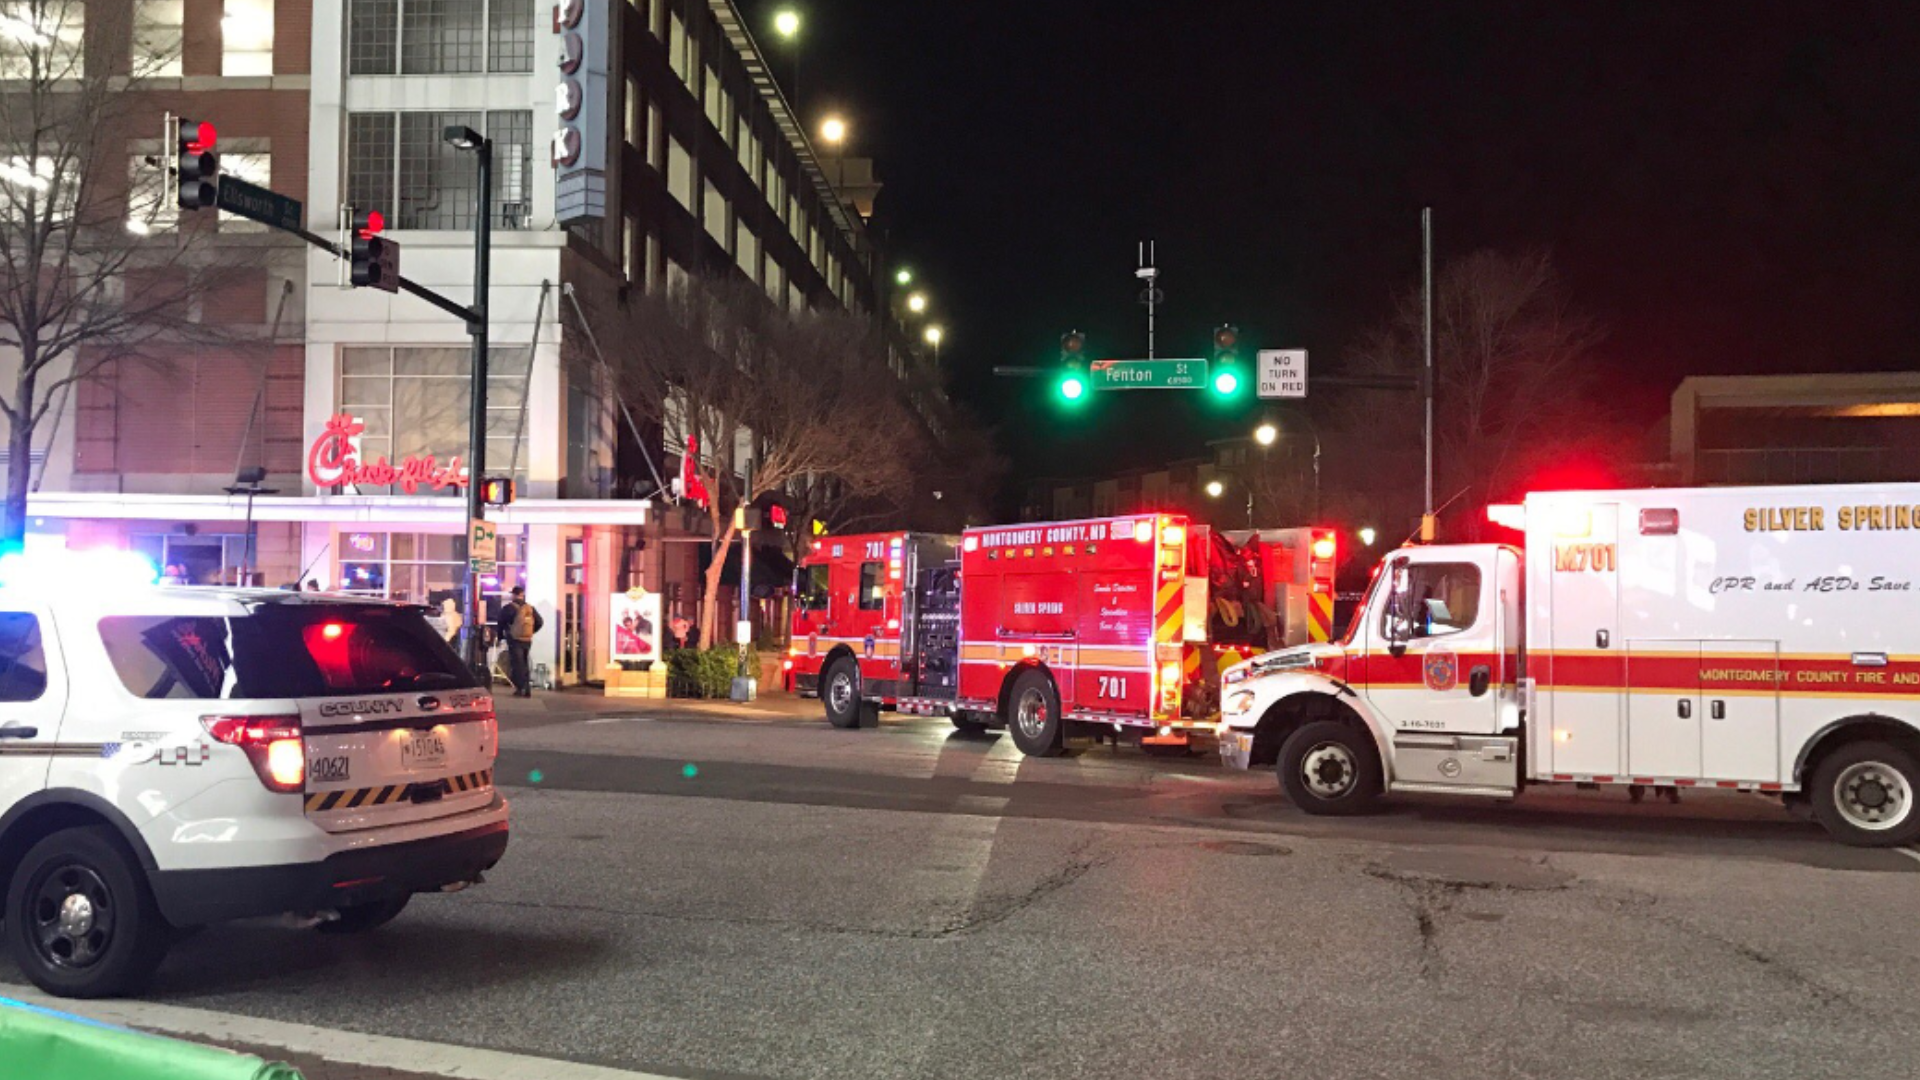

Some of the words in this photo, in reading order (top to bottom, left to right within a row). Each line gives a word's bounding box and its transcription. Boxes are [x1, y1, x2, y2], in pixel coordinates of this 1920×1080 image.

[1274, 356, 1290, 365] NO
[1106, 367, 1152, 381] Fenton
[1176, 363, 1188, 374] St
[1269, 369, 1296, 378] TURN
[1261, 382, 1276, 391] ON
[1282, 382, 1303, 391] RED
[1744, 507, 1824, 532] SILVER
[865, 541, 884, 559] 701
[1555, 543, 1616, 572] M701
[1709, 576, 1756, 594] CPR
[1764, 578, 1796, 591] and
[1803, 576, 1859, 593] AEDs
[1867, 576, 1912, 591] Save
[1699, 669, 1790, 682] MONTGOMERY
[1797, 670, 1848, 683] COUNTY
[1855, 672, 1886, 684] FIRE
[1892, 672, 1920, 685] AND
[1098, 676, 1126, 699] 701
[319, 699, 404, 717] COUNTY
